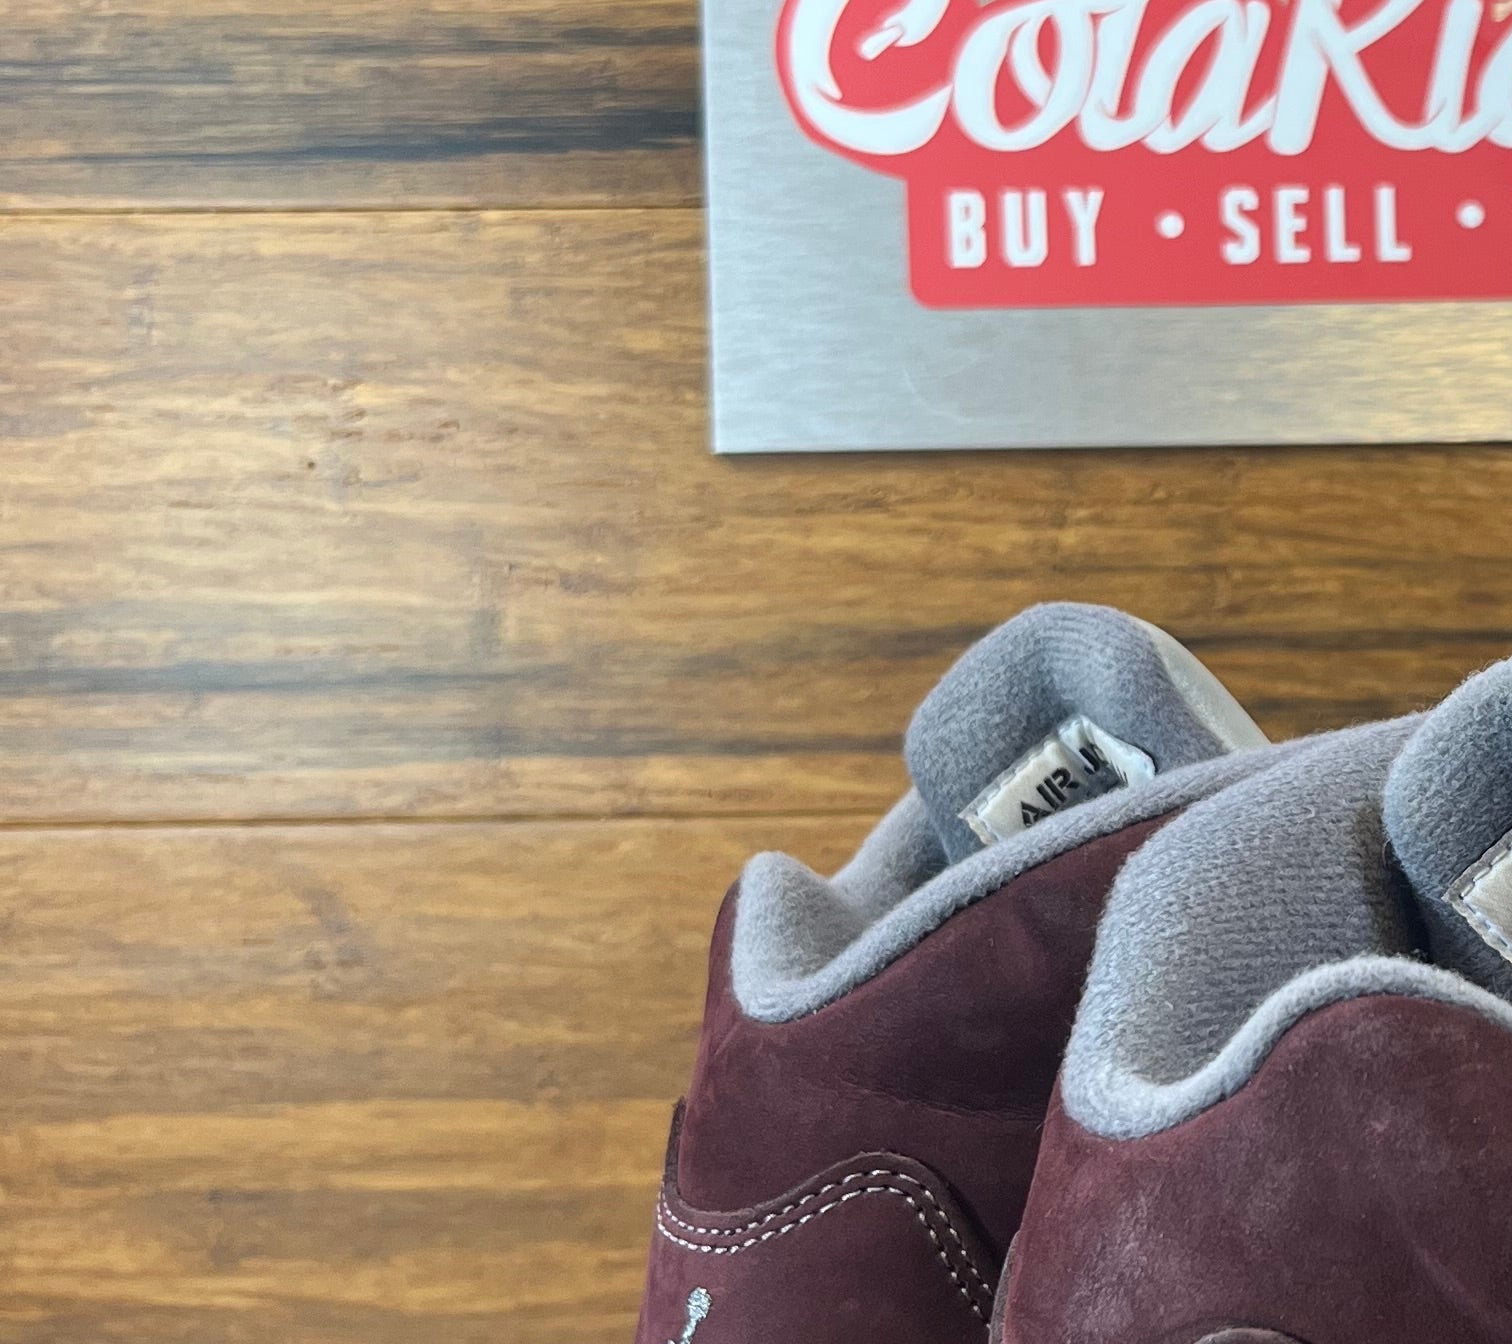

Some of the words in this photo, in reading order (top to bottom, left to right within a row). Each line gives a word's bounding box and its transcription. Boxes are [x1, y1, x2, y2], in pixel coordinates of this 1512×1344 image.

[946, 189, 1106, 268] BUY
[1220, 183, 1412, 264] SELL
[1019, 766, 1080, 828] AIR
